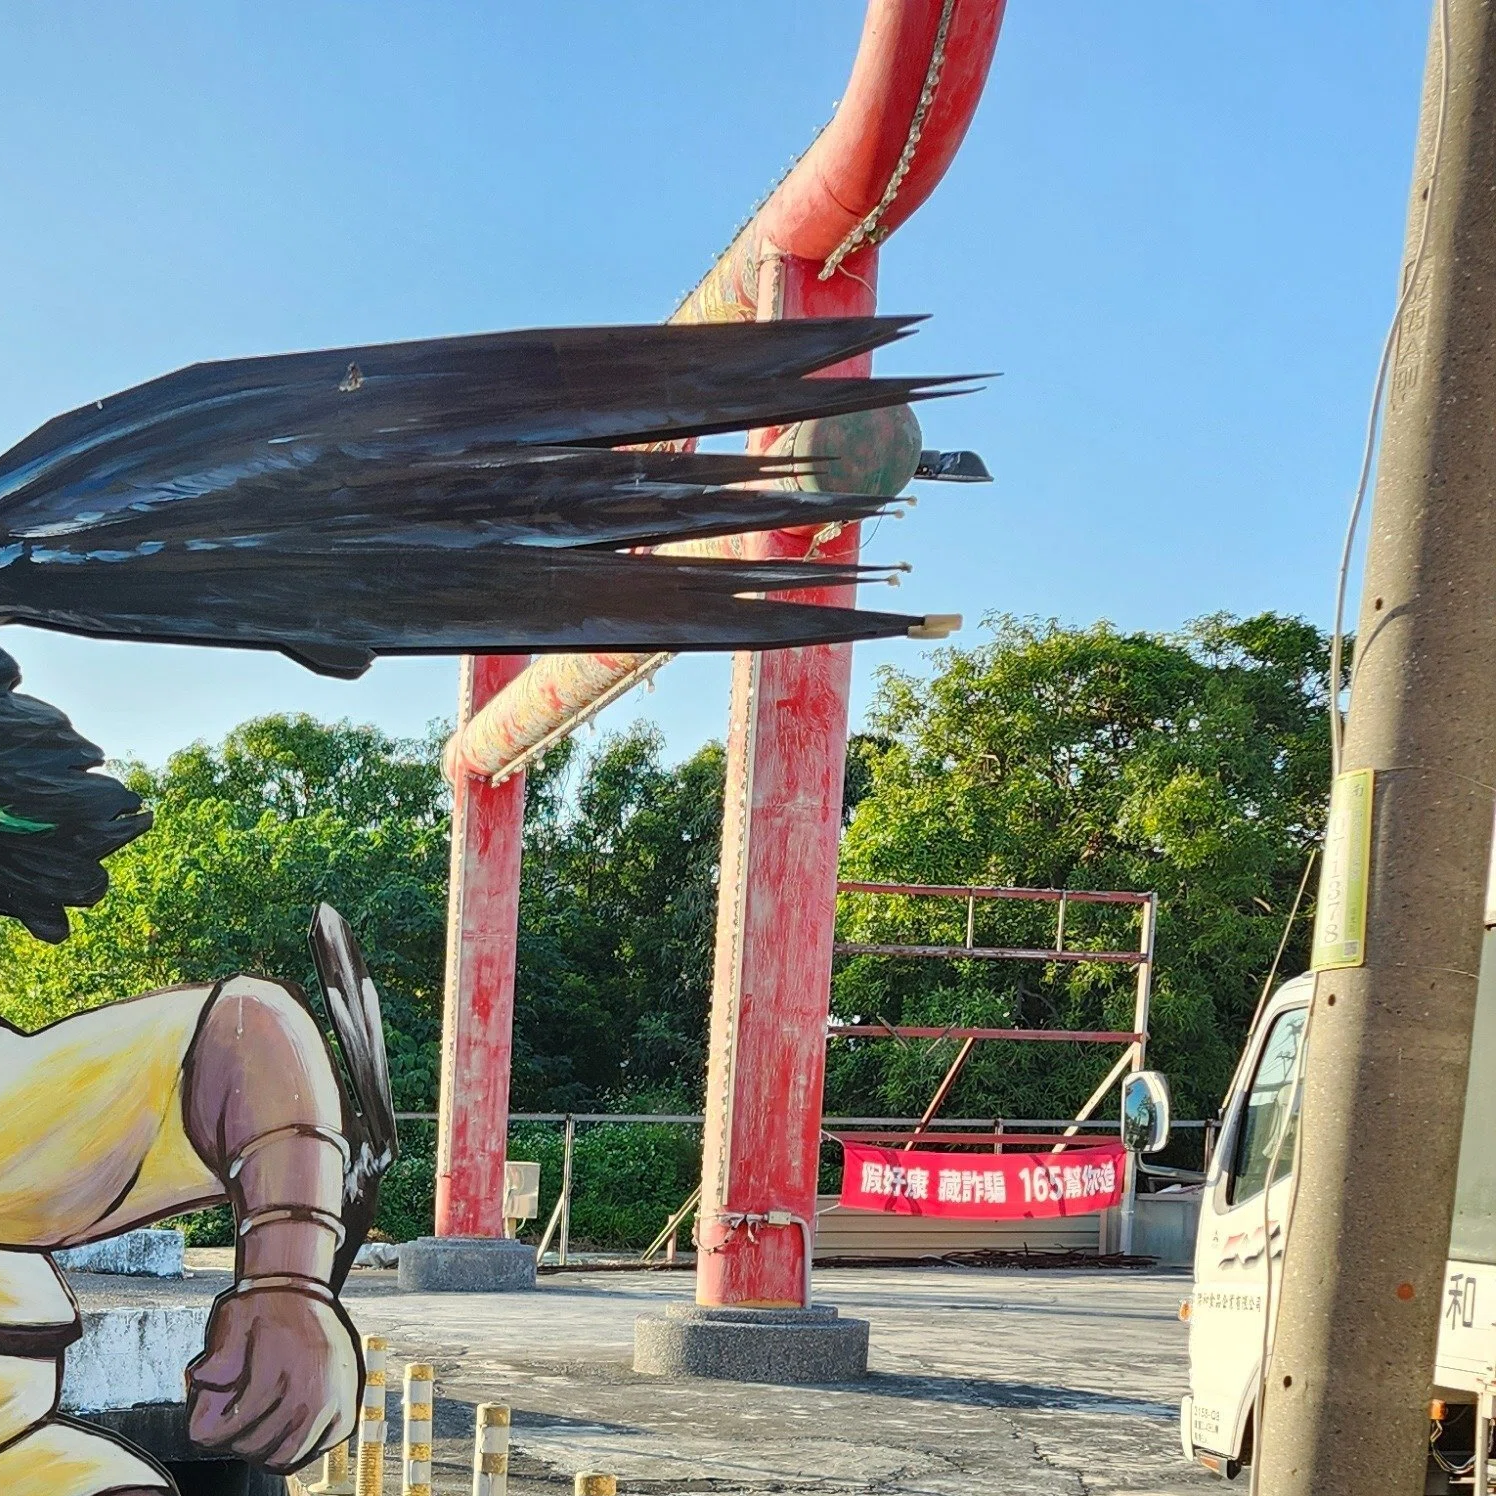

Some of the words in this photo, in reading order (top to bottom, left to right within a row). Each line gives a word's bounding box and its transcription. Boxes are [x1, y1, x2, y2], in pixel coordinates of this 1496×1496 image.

[861, 1161, 930, 1200] 假好康
[937, 1168, 1007, 1203] 藏詐騙
